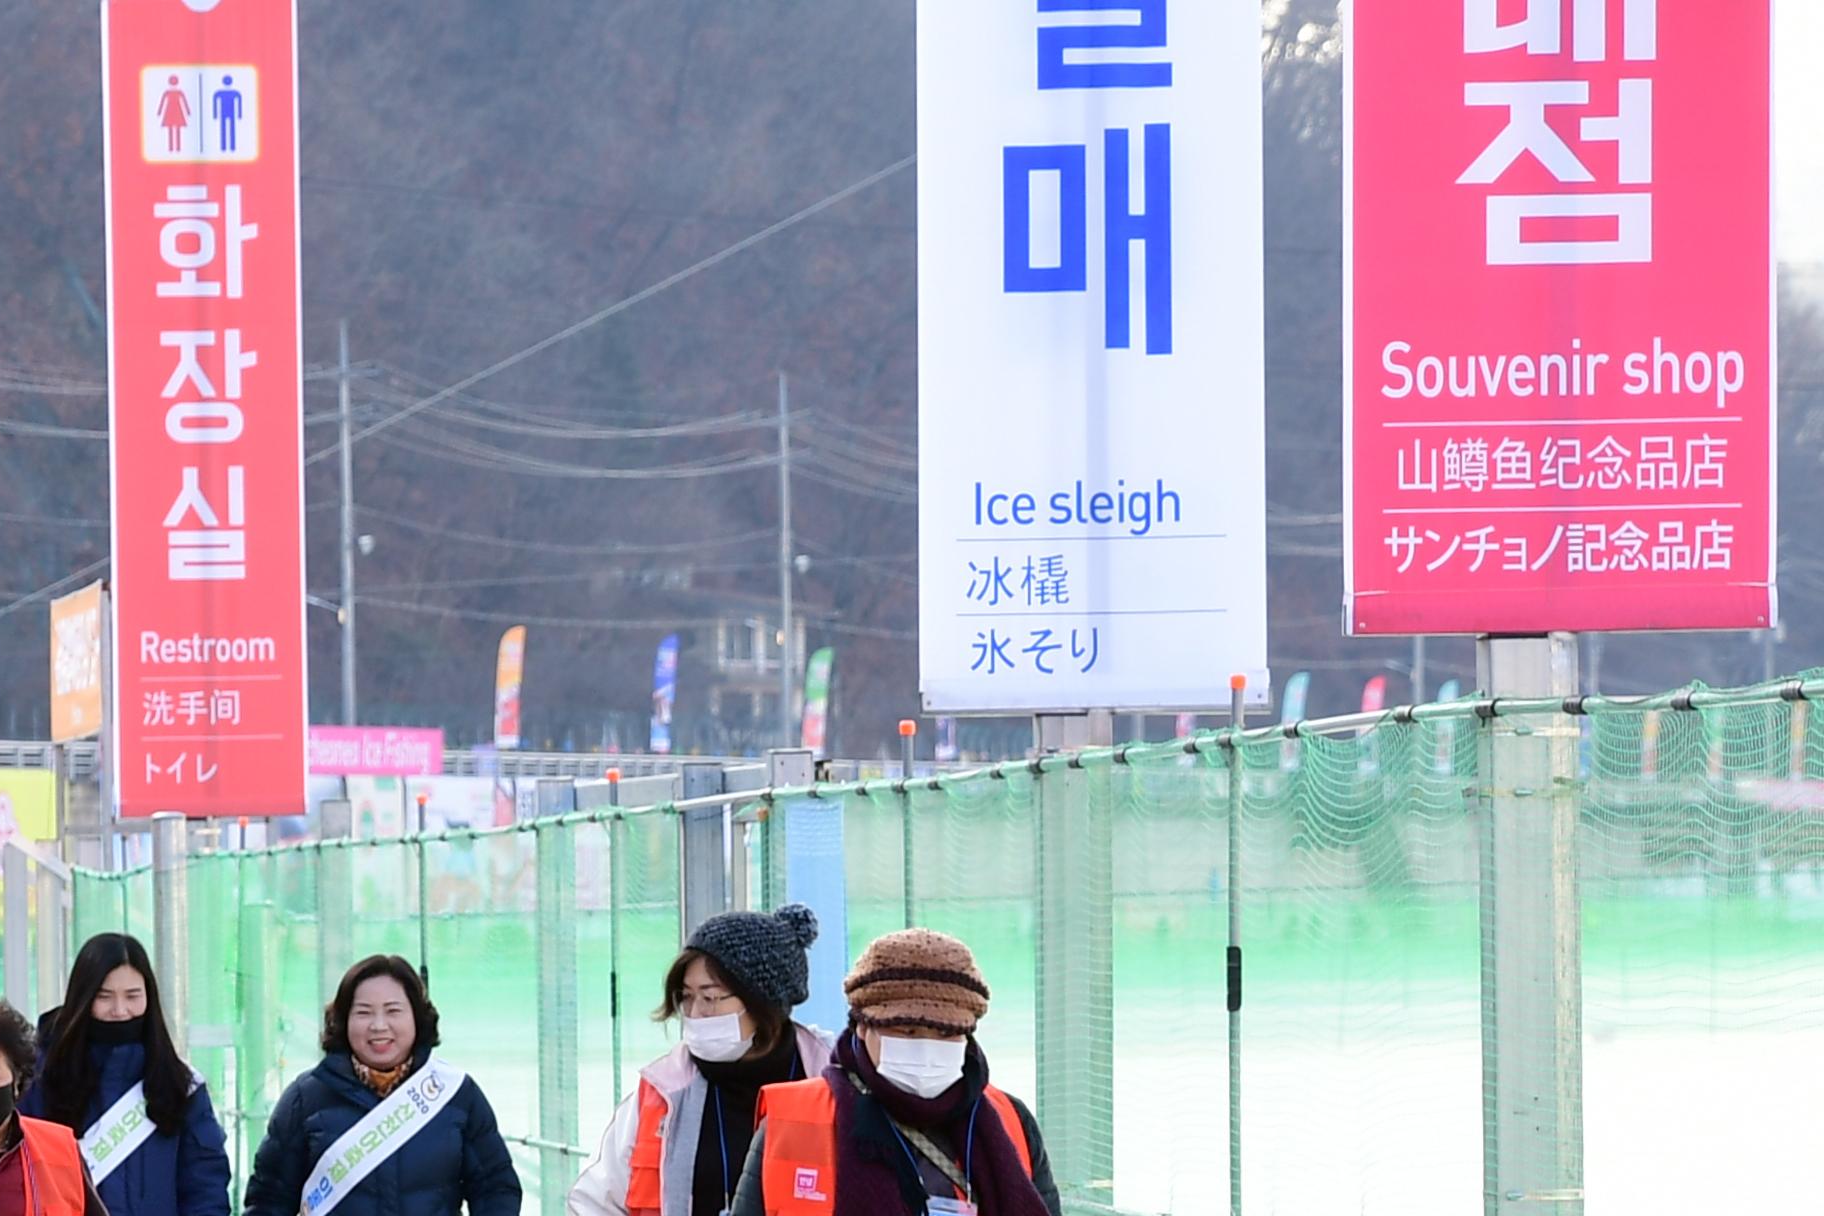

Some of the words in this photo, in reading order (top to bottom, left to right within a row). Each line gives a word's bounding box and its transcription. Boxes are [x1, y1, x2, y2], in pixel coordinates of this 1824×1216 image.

[153, 184, 259, 582] 화장실
[1381, 339, 1609, 400] Souvenir
[1622, 336, 1745, 409] shop
[1397, 433, 1729, 493] 山鳟鱼纪念品店
[973, 481, 1036, 526] Ice
[1049, 478, 1181, 535] sleigh
[1383, 518, 1734, 574] サンチョノ記念品店
[966, 554, 1070, 607] 冰橇
[140, 631, 276, 664] Restroom
[970, 627, 1101, 675] 氷そり
[142, 689, 241, 726] 洗手间
[145, 752, 218, 785] トイレ
[407, 1086, 430, 1114] 2020
